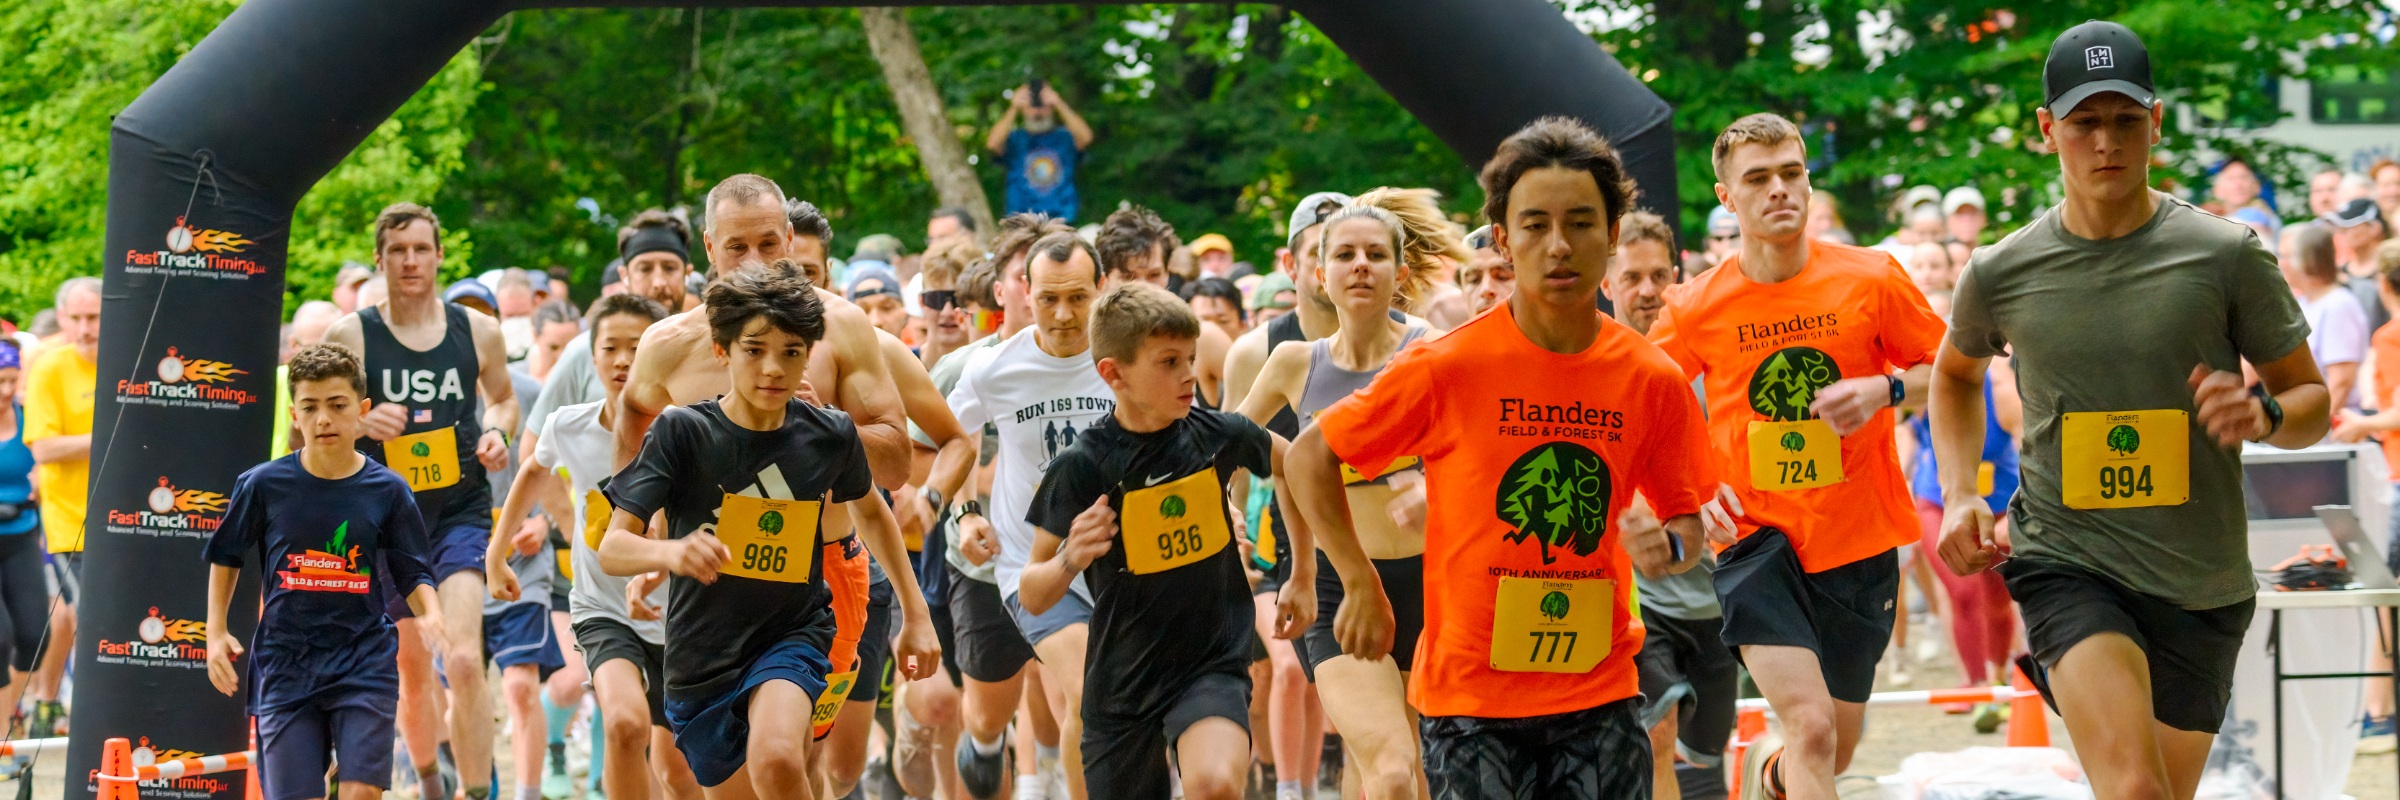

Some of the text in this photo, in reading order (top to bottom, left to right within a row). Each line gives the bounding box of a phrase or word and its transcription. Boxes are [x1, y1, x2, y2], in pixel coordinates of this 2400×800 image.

[1737, 313, 1838, 343] Flanders
[1739, 341, 1769, 353] FIELD
[1781, 332, 1822, 345] FOREST
[382, 367, 464, 403] USA
[1016, 402, 1045, 424] RUN
[1051, 397, 1072, 413] 169
[1499, 398, 1623, 429] Flanders
[1499, 425, 1623, 443] FIELD & FOREST 5K
[409, 462, 441, 485] 718
[1777, 459, 1817, 484] 724
[2100, 465, 2154, 499] 994
[1575, 456, 1604, 534] 2025
[1157, 524, 1203, 560] 936
[294, 555, 342, 570] Flanders
[742, 543, 788, 573] 986
[1489, 566, 1518, 578] 10TH
[1529, 631, 1578, 663] 777
